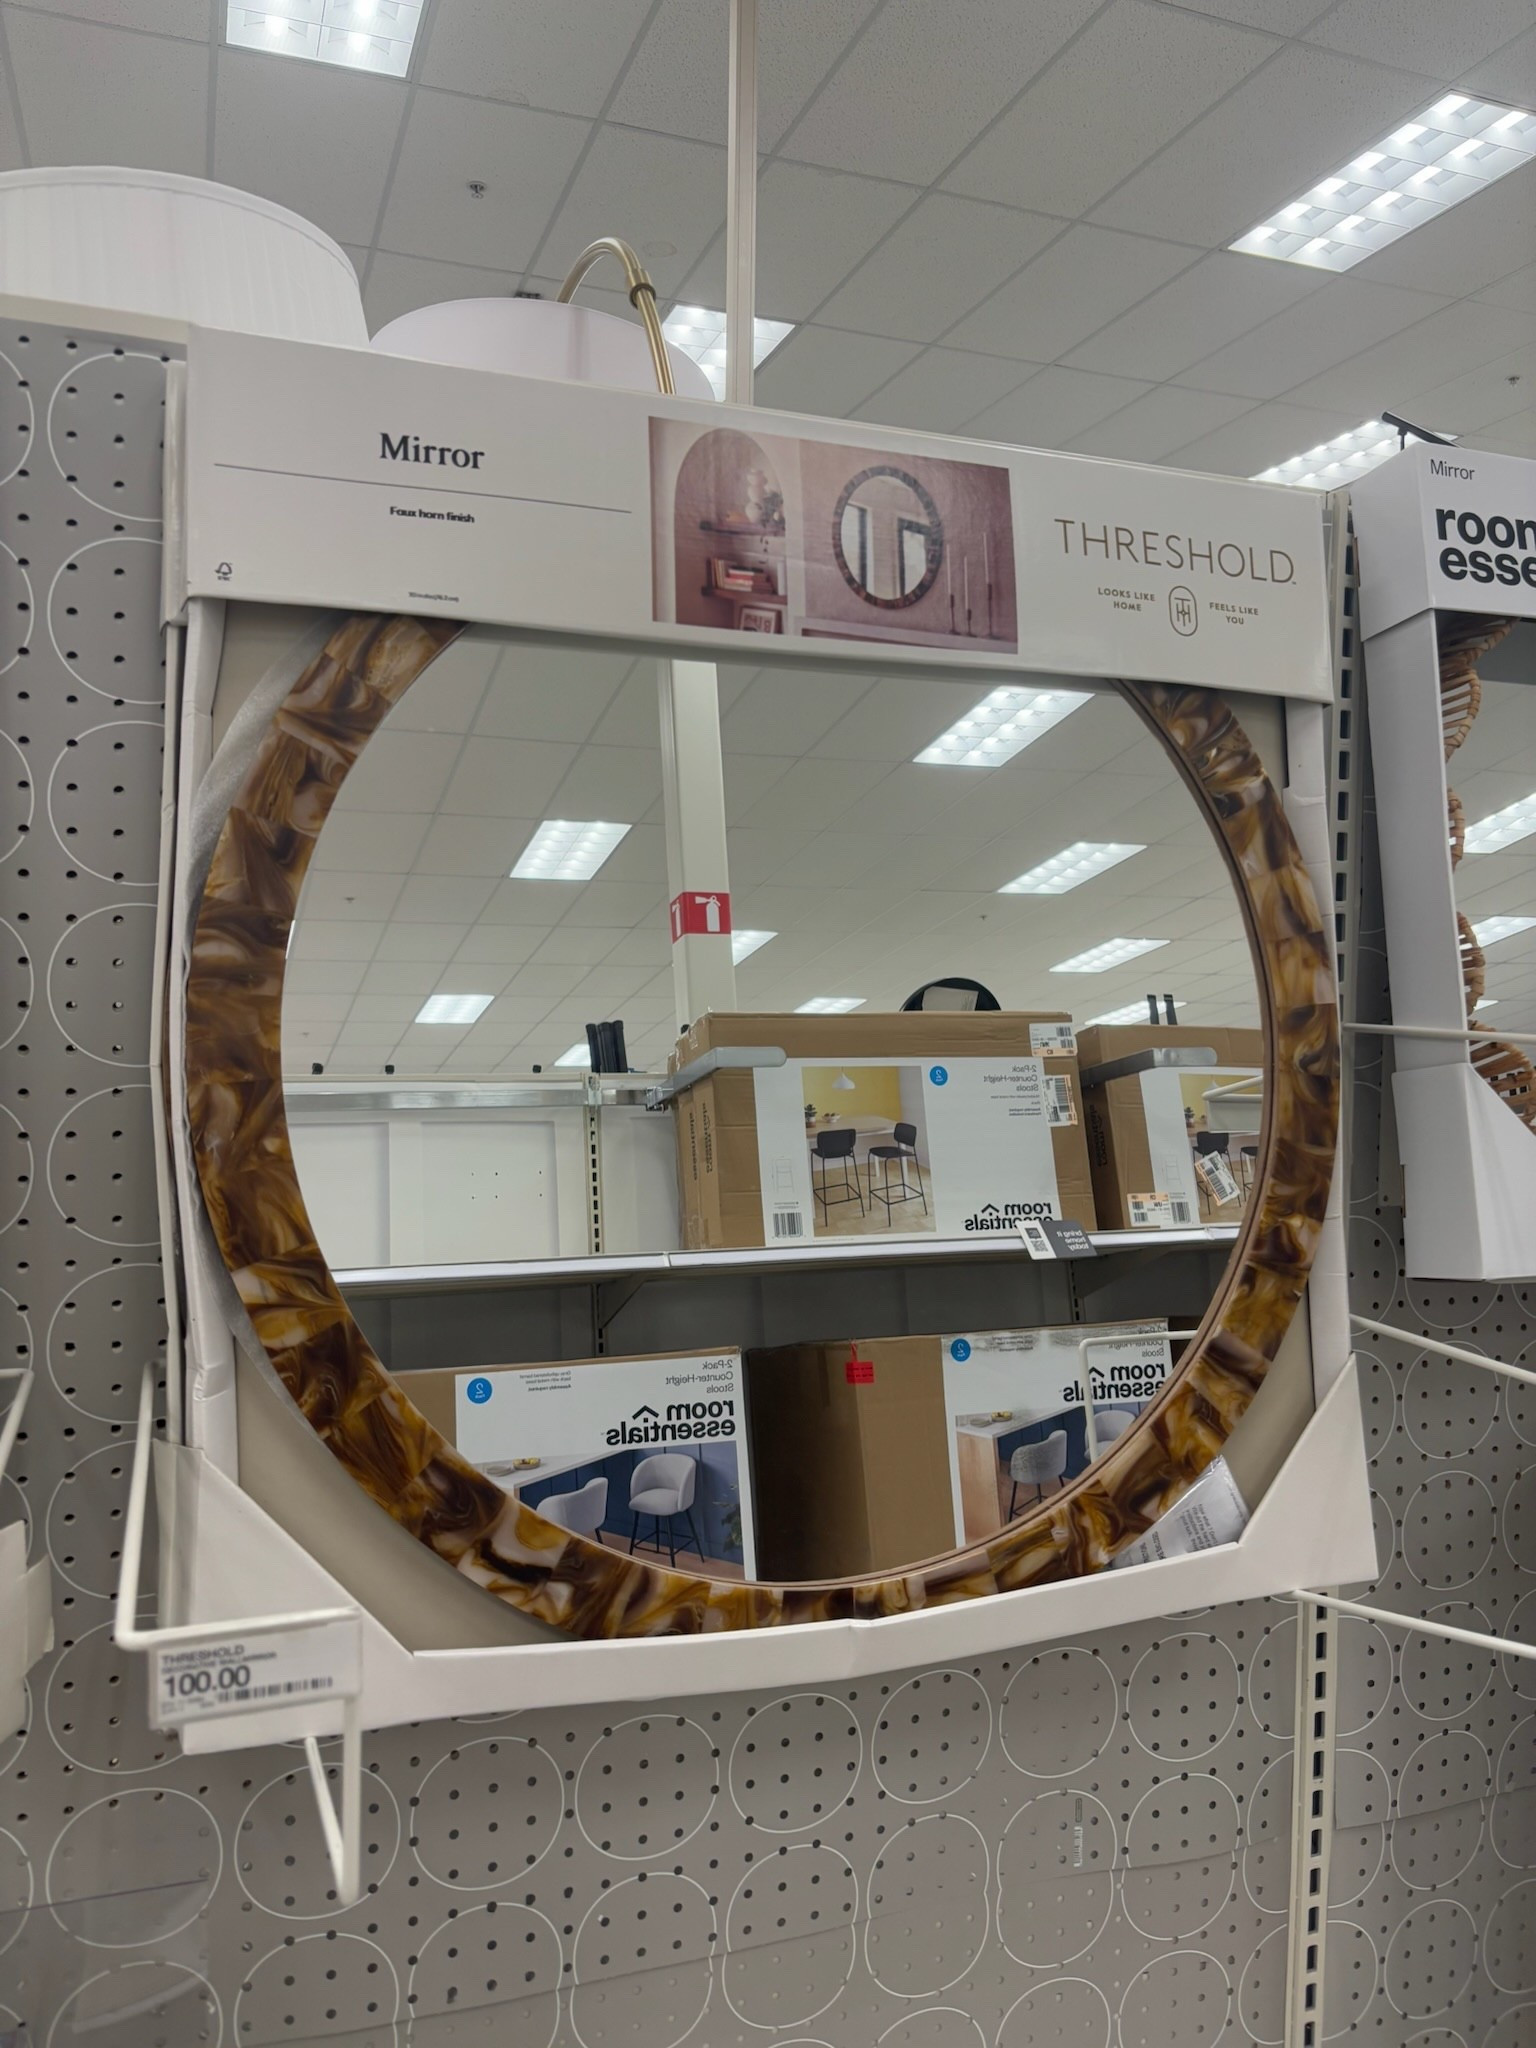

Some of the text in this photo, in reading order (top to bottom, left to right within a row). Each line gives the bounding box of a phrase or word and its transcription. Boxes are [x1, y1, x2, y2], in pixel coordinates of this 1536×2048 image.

[380, 432, 485, 469] Mirror
[1430, 458, 1475, 480] Mirror
[390, 505, 475, 524] Faux horn finish
[1054, 518, 1295, 585] THRESHOLD
[1097, 587, 1156, 602] LOOKS LIKE
[1113, 601, 1142, 612] HOME
[1209, 602, 1259, 616] FEELS LIKE
[1225, 615, 1245, 625] YOU
[161, 1644, 245, 1666] THRESHOLD
[164, 1664, 251, 1698] 100.00
